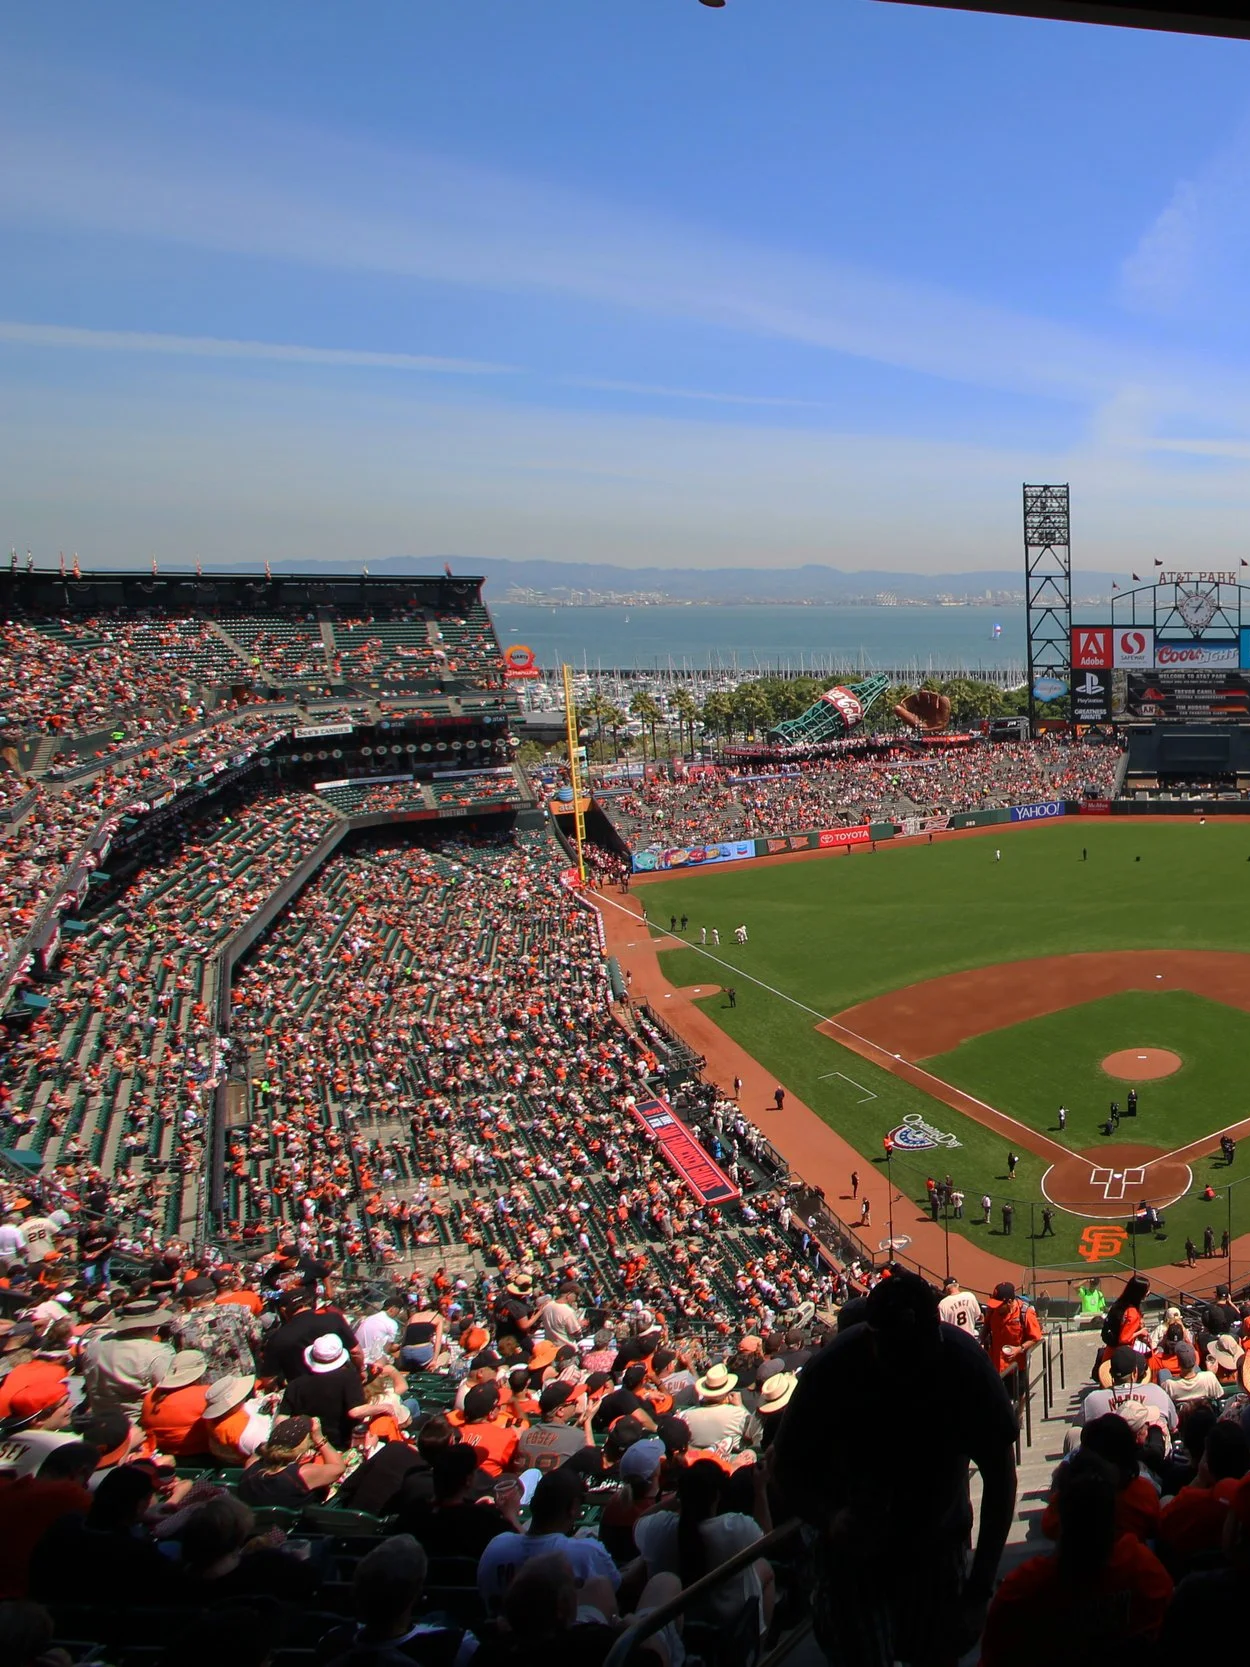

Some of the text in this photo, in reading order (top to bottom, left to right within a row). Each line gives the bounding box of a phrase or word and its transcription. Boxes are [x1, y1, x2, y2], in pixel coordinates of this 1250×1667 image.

[1159, 572, 1237, 584] AT&T PARK
[1080, 656, 1104, 666] Adobe
[1158, 645, 1204, 664] Coors
[1015, 803, 1060, 820] YAHOO!
[834, 830, 869, 840] TOYOTA
[28, 1229, 47, 1243] 28
[1078, 1225, 1128, 1262] SF
[950, 1299, 970, 1311] PENCE
[956, 1311, 968, 1326] 8
[525, 1431, 559, 1446] POSEY
